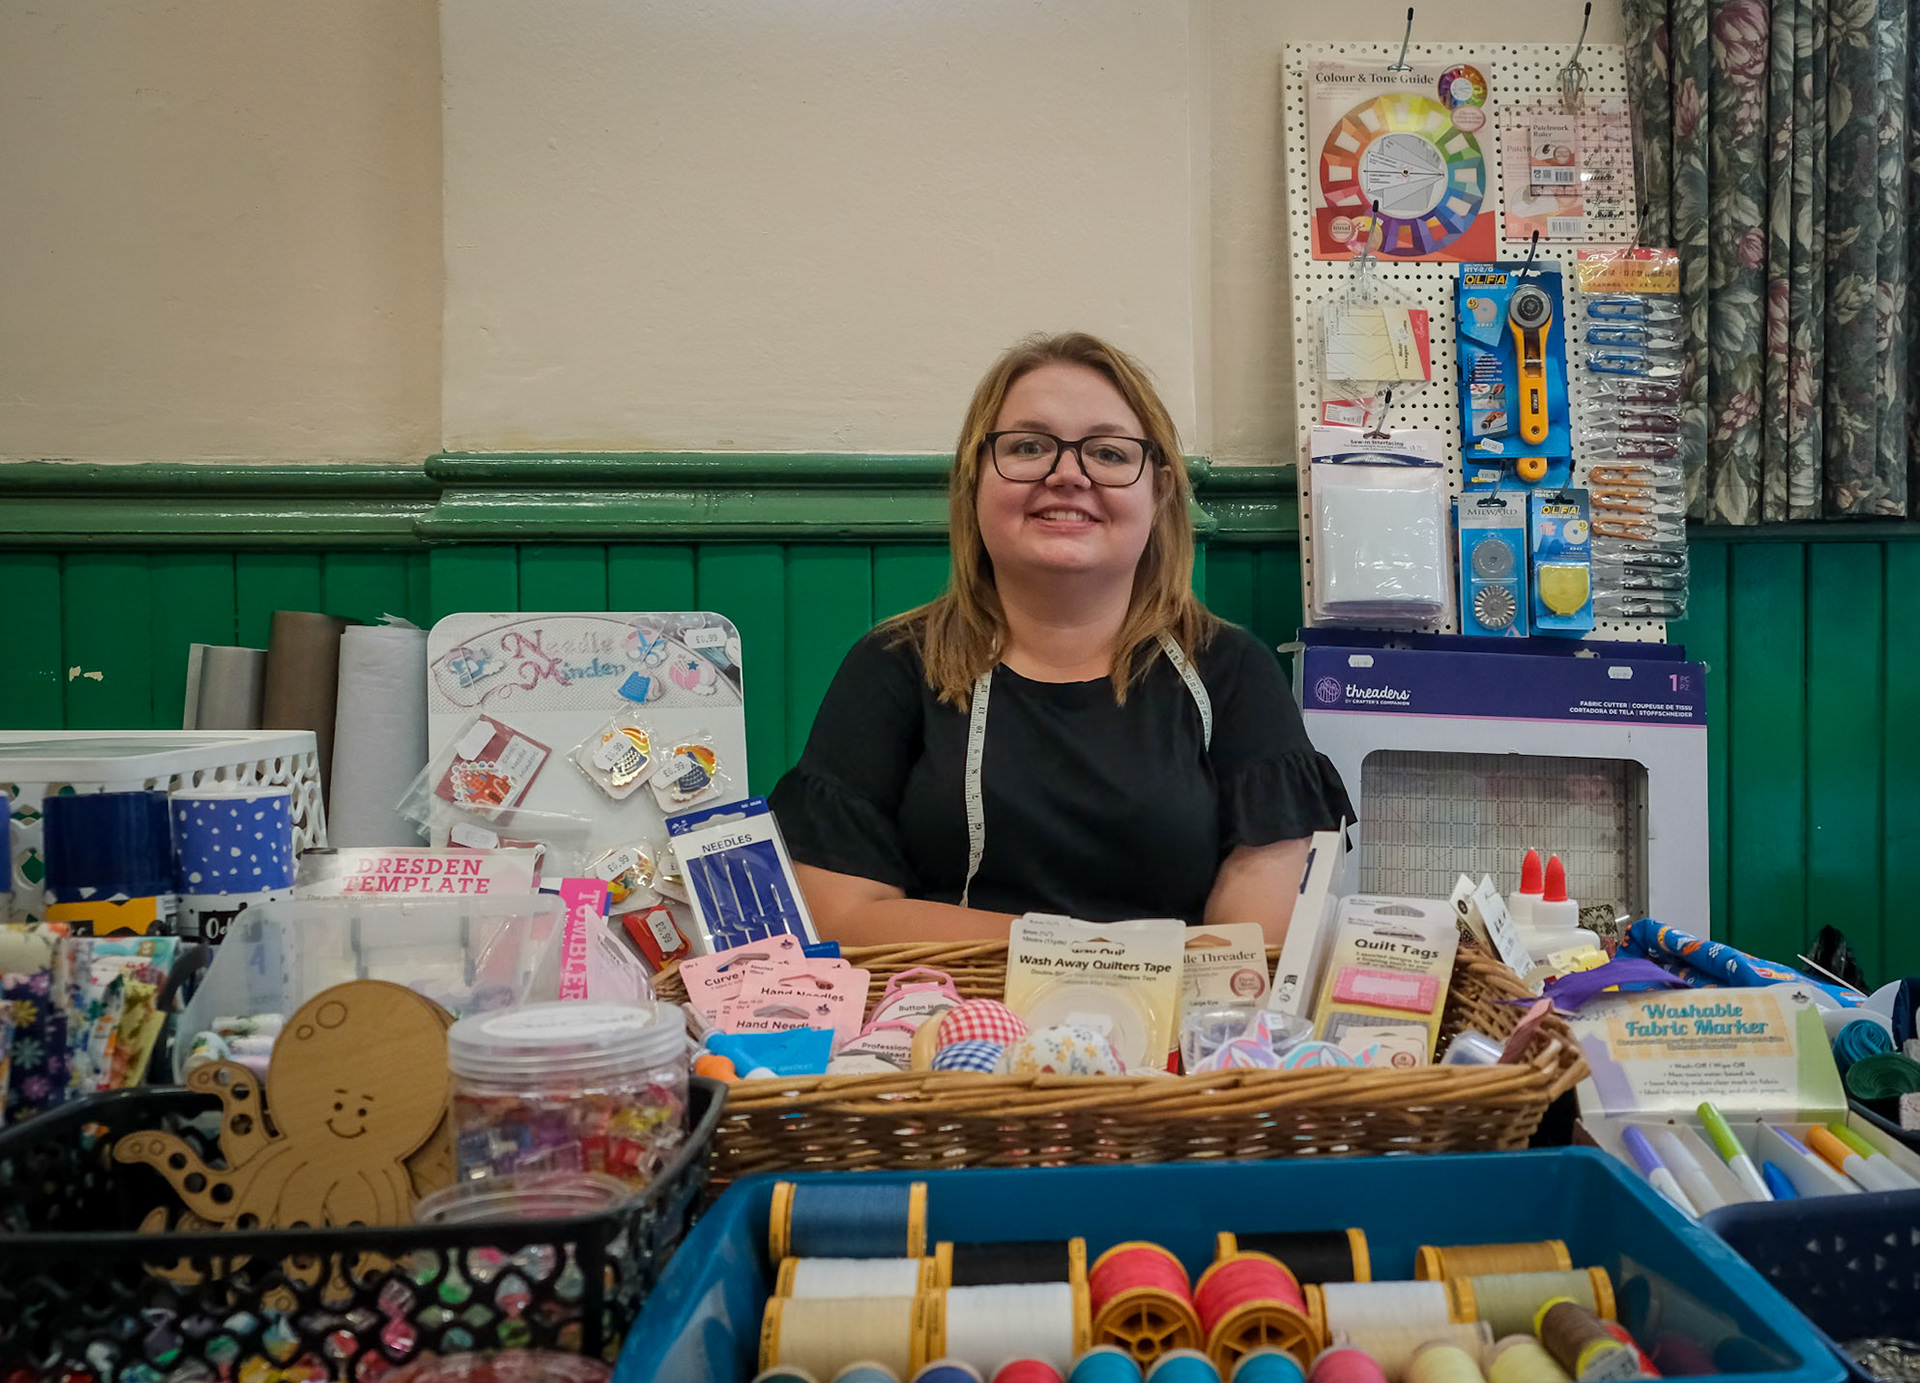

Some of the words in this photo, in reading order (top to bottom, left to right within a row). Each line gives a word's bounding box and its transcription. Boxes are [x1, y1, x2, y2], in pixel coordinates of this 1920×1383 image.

[1316, 72, 1355, 84] Colour
[1358, 74, 1366, 82] &
[1370, 74, 1397, 84] Tone
[1400, 74, 1434, 84] Guide
[1465, 275, 1508, 285] OLFA
[1542, 506, 1579, 514] OLFA
[1669, 674, 1678, 692] 1
[702, 834, 752, 854] NEEDLES
[356, 858, 483, 876] DRESDEN
[343, 876, 490, 894] TEMPLATE
[1199, 951, 1257, 963] Threader
[1355, 938, 1396, 952] Quilt
[1401, 944, 1439, 960] Tags
[1020, 955, 1052, 966] Wash
[1054, 958, 1089, 971] Away
[1093, 960, 1140, 972] Quilters
[1144, 962, 1172, 973] Tape
[704, 973, 739, 986] Curve
[1642, 1003, 1744, 1020] Washable
[736, 1020, 768, 1030] Hand
[1624, 1020, 1689, 1038] Fabric
[1694, 1020, 1768, 1036] Marker
